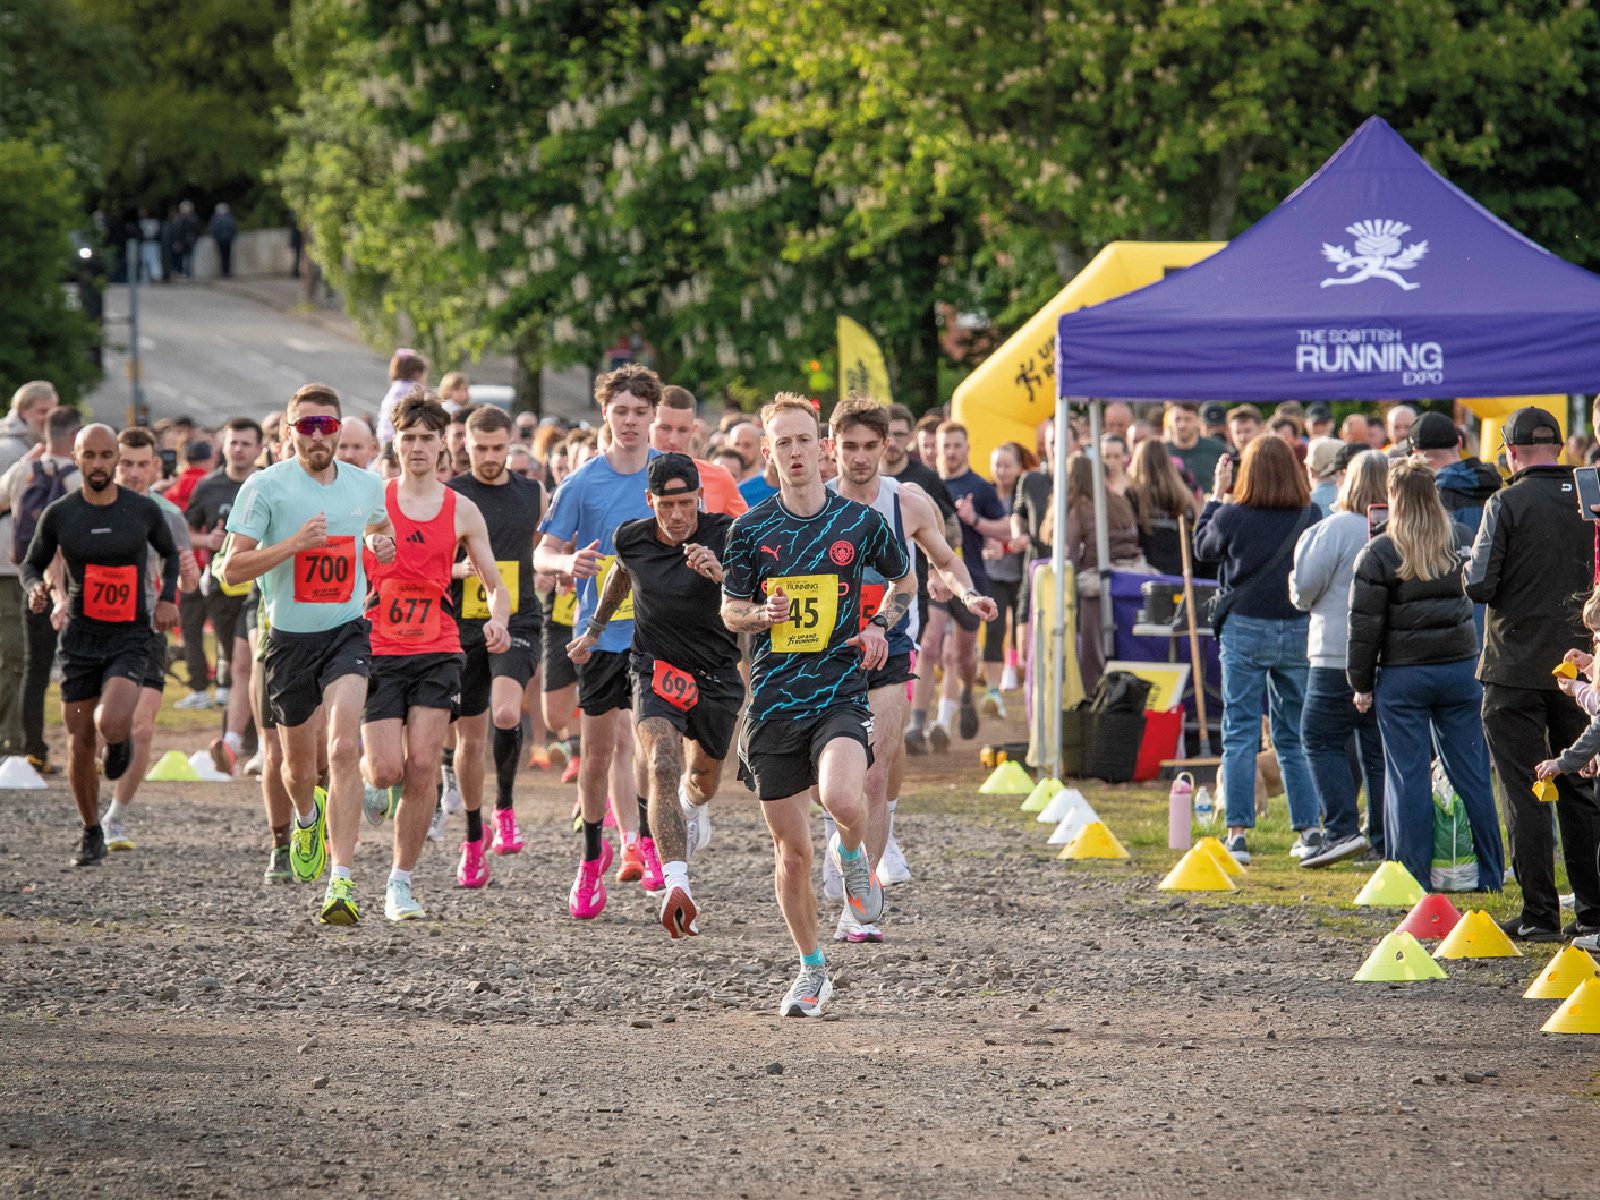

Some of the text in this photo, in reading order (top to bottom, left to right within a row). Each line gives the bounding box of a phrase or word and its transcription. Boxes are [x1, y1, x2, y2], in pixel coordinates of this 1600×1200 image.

[1297, 328, 1402, 344] THE SCOTTISH
[1296, 341, 1443, 373] RUNNING
[1402, 370, 1443, 386] EXPO
[305, 555, 349, 583] 700
[93, 582, 130, 606] 709
[389, 598, 433, 624] 677
[789, 597, 819, 629] 45
[662, 670, 698, 707] 692
